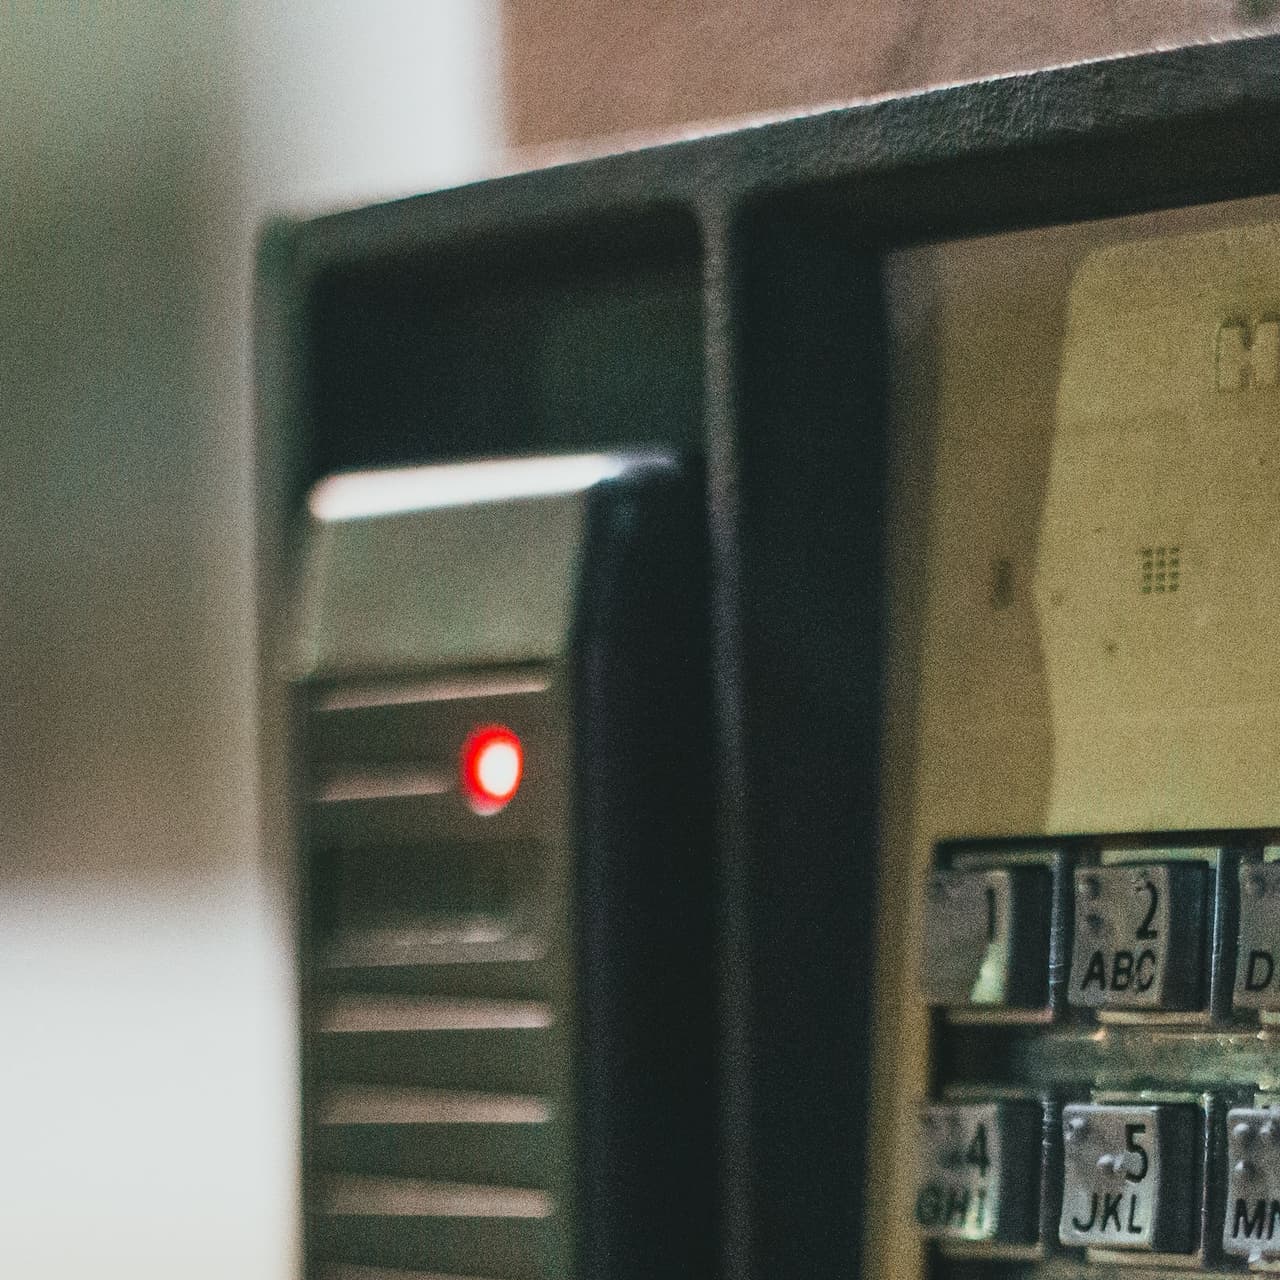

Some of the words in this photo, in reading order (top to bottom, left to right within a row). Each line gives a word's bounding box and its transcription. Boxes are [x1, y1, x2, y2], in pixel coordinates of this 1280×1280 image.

[1135, 880, 1159, 940] 2
[1081, 949, 1158, 992] ABC
[966, 1121, 991, 1179] 4
[1123, 1123, 1149, 1184] 5
[1072, 1192, 1144, 1235] JKL
